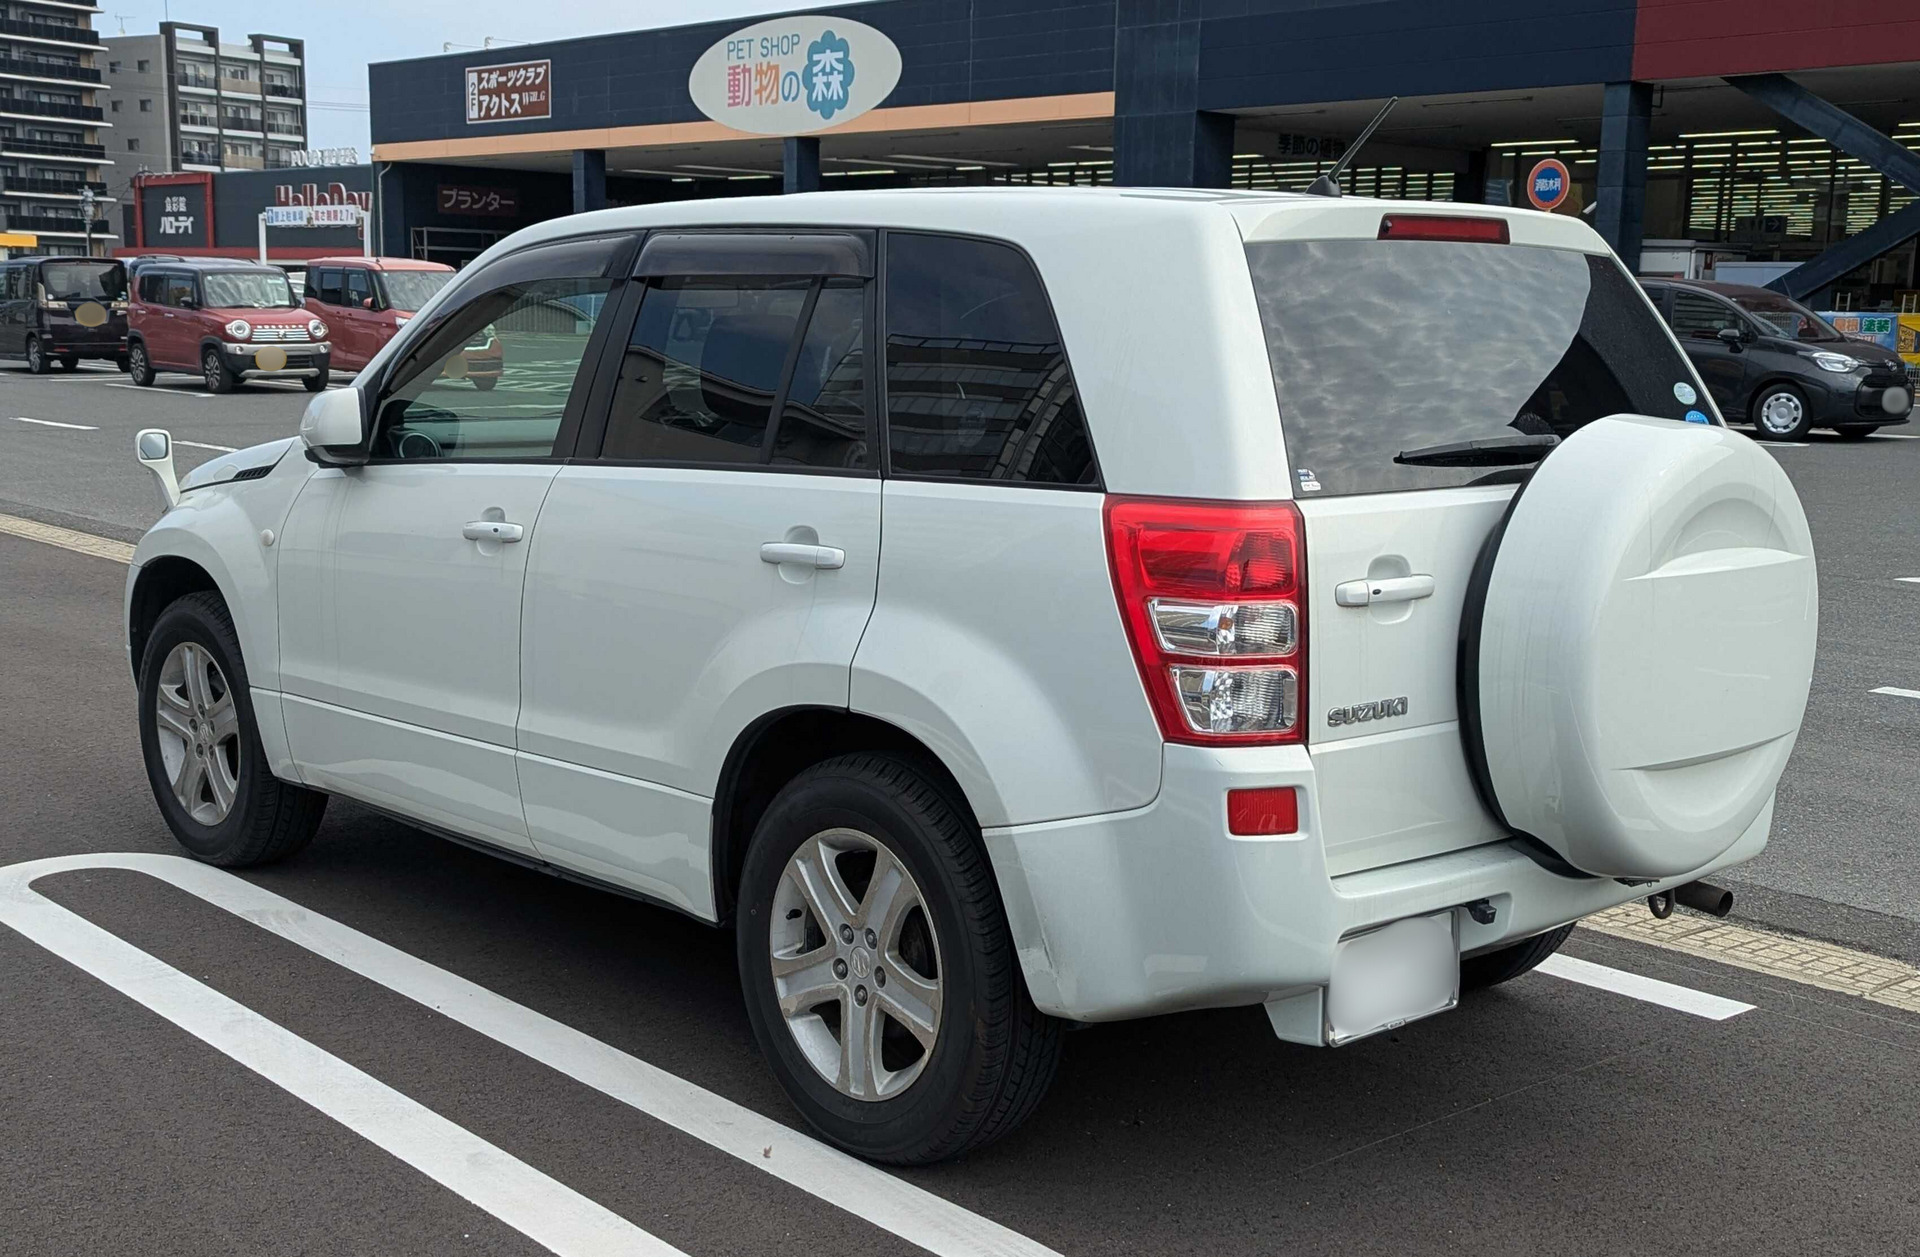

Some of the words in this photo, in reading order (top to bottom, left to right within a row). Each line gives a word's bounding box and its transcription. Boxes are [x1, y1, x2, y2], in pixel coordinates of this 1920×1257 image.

[727, 39, 754, 61] PET
[760, 33, 800, 58] SHOP
[479, 65, 547, 90] スポーツクラブ
[727, 49, 844, 108] 動物の森
[470, 82, 477, 112] 2F
[479, 93, 521, 118] アクトス
[442, 189, 515, 211] プランター
[1862, 317, 1891, 334] 塗装
[1327, 697, 1408, 727] SUZUKI
